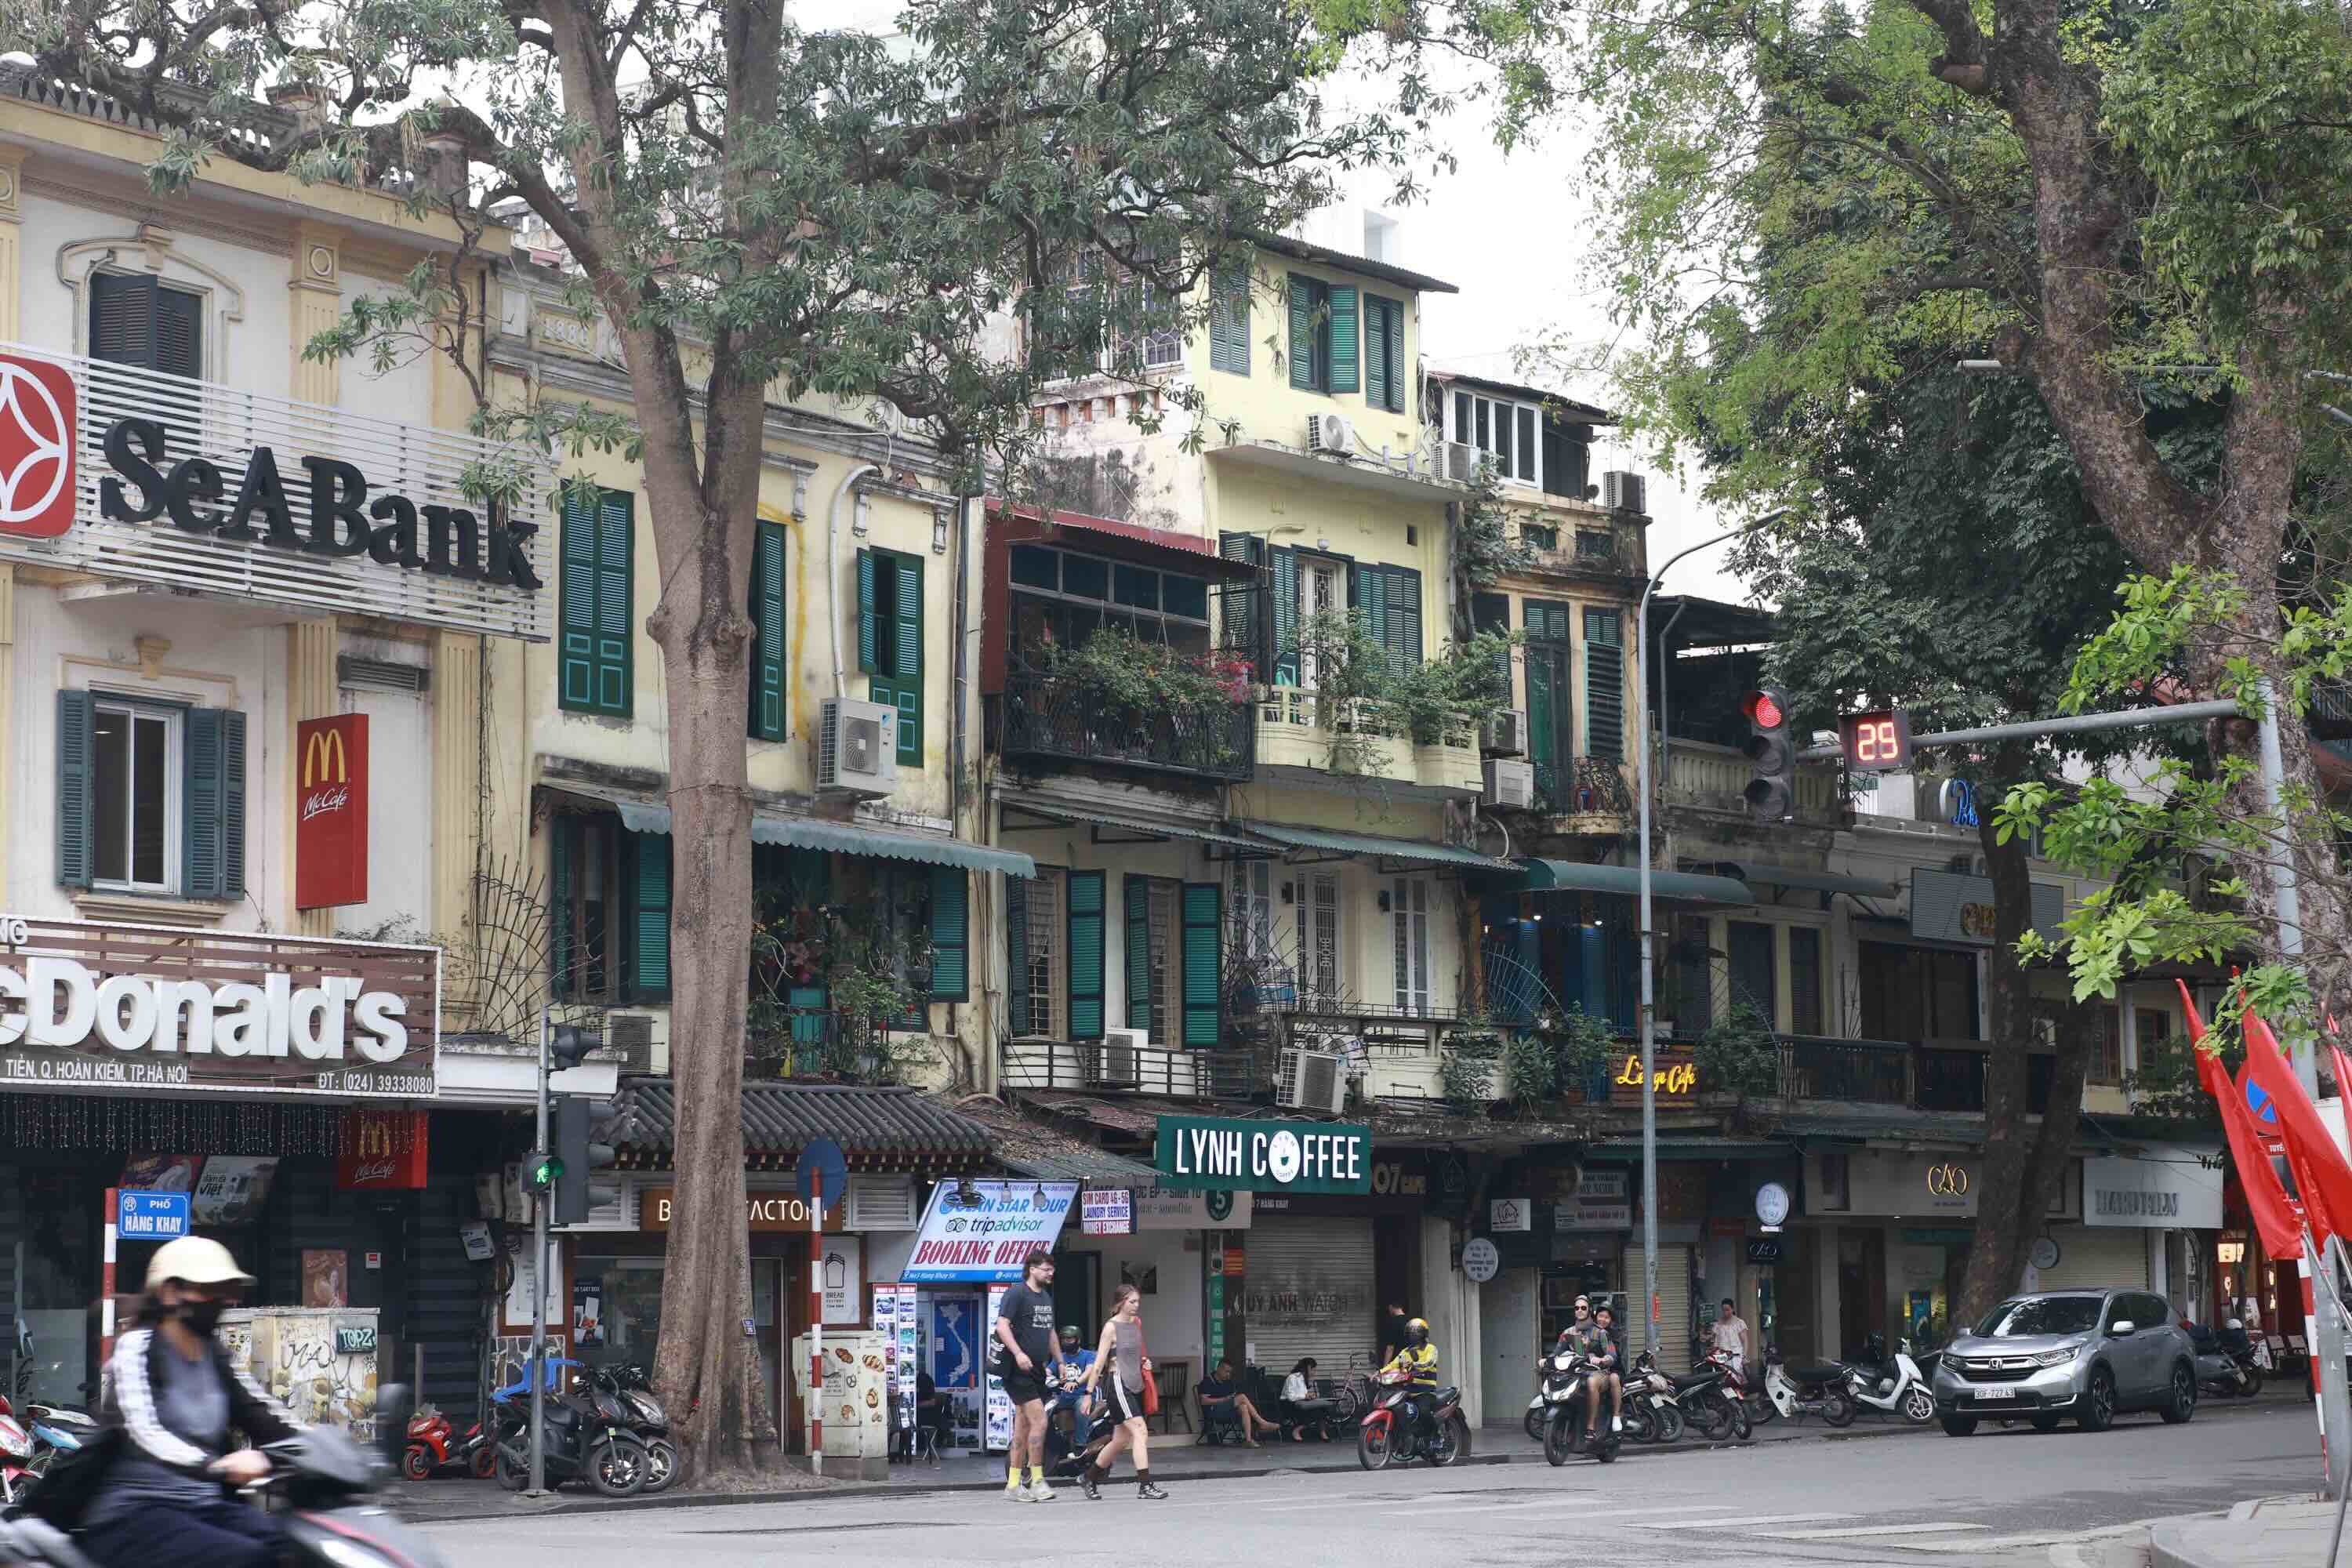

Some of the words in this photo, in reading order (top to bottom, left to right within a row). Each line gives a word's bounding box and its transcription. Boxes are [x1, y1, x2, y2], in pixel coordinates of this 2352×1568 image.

[100, 417, 543, 590] SeABank
[1857, 721, 1898, 760] 29
[41, 1060, 53, 1080] Q.
[56, 1058, 92, 1080] HOÀN
[343, 1071, 373, 1092] (024)
[377, 1075, 433, 1093] 39338080
[1176, 1129, 1243, 1177] LYNH
[150, 1197, 172, 1209] PHỐ
[1083, 1192, 1094, 1205] SIM
[1094, 1192, 1109, 1204] CARD
[746, 1199, 828, 1221] ACTO
[1083, 1207, 1105, 1218] LAUNDRY
[1107, 1206, 1128, 1218] SERVICE
[125, 1213, 154, 1232] HÀNG
[156, 1216, 182, 1233] KHAY
[970, 1215, 1044, 1236] tripadvisor
[914, 1240, 993, 1265] BOOKING
